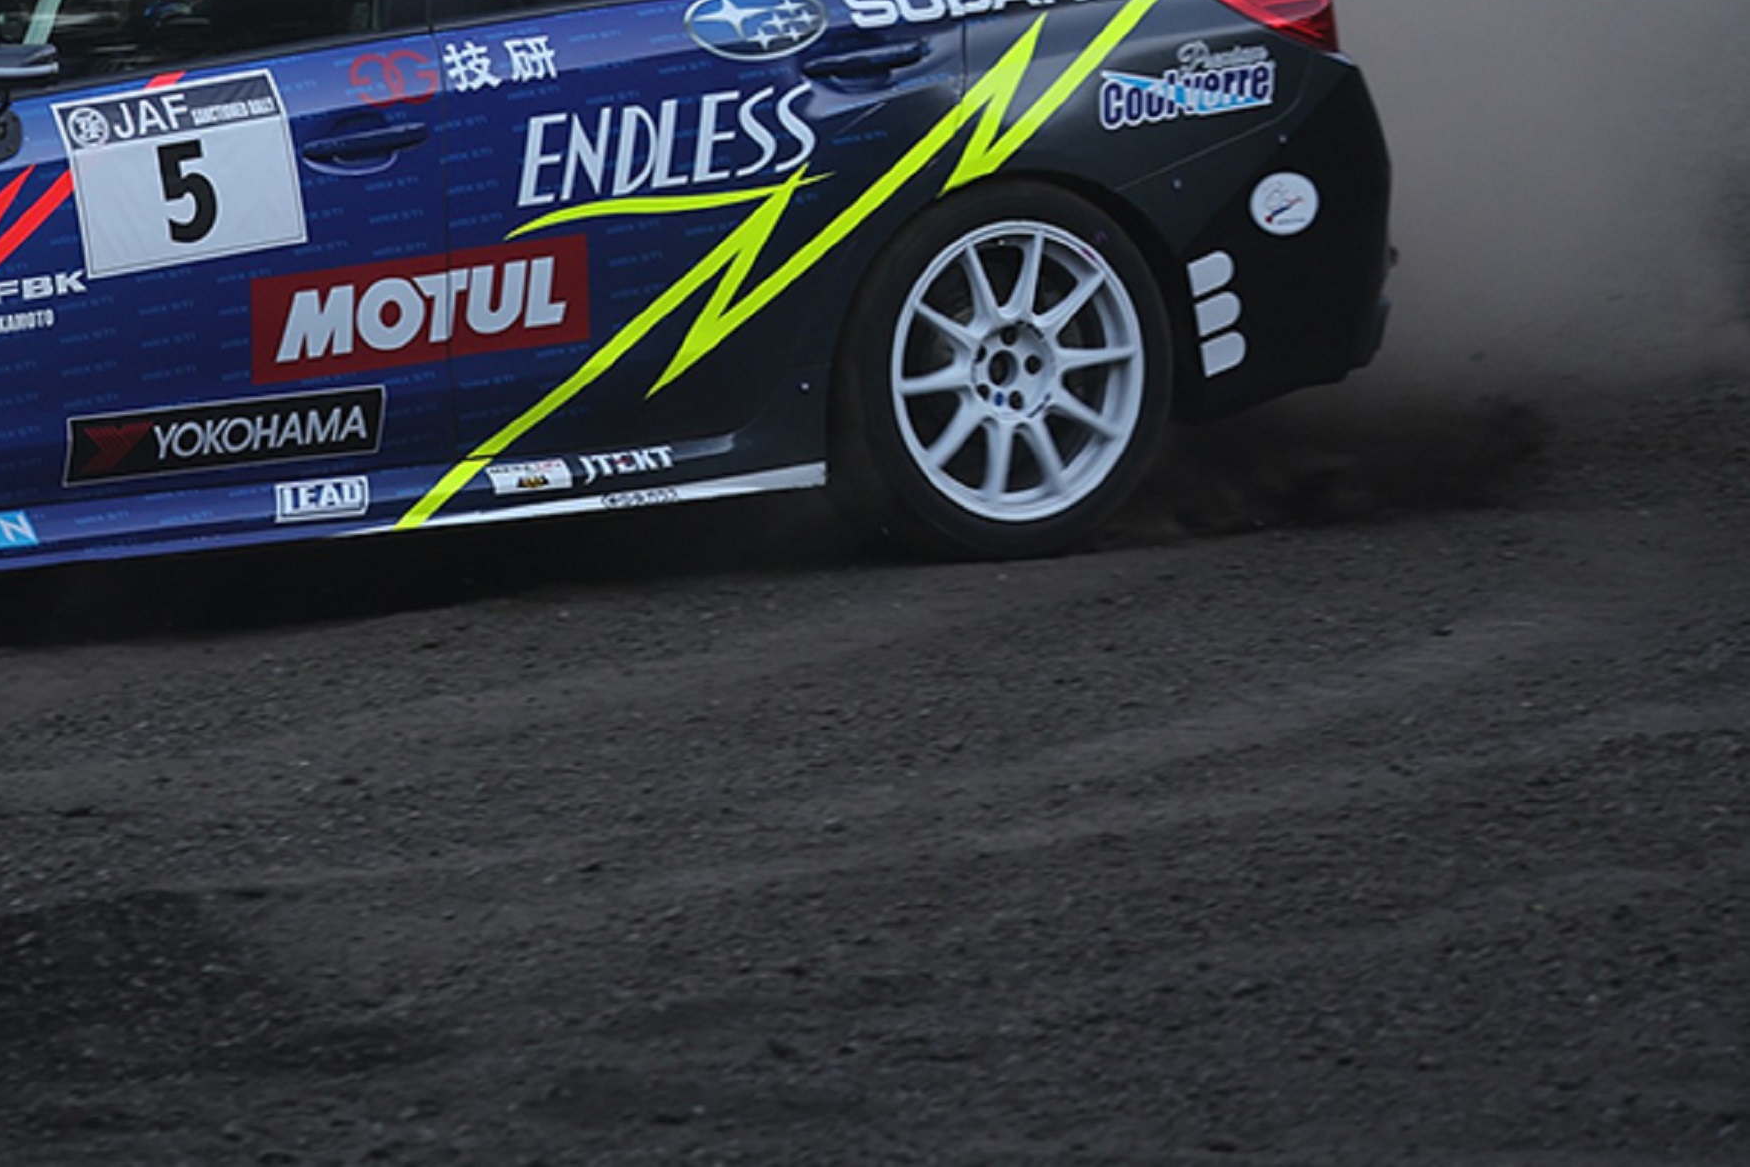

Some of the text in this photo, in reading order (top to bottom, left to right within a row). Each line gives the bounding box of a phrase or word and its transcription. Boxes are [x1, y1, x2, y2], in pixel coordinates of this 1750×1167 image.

[444, 34, 559, 94] 技研
[113, 93, 188, 139] JAF
[517, 80, 817, 208] ENDLESS
[157, 138, 218, 244] 5
[275, 256, 567, 365] MOTUL
[154, 404, 369, 460] YOKOHAMA
[578, 444, 676, 485] JTEKT
